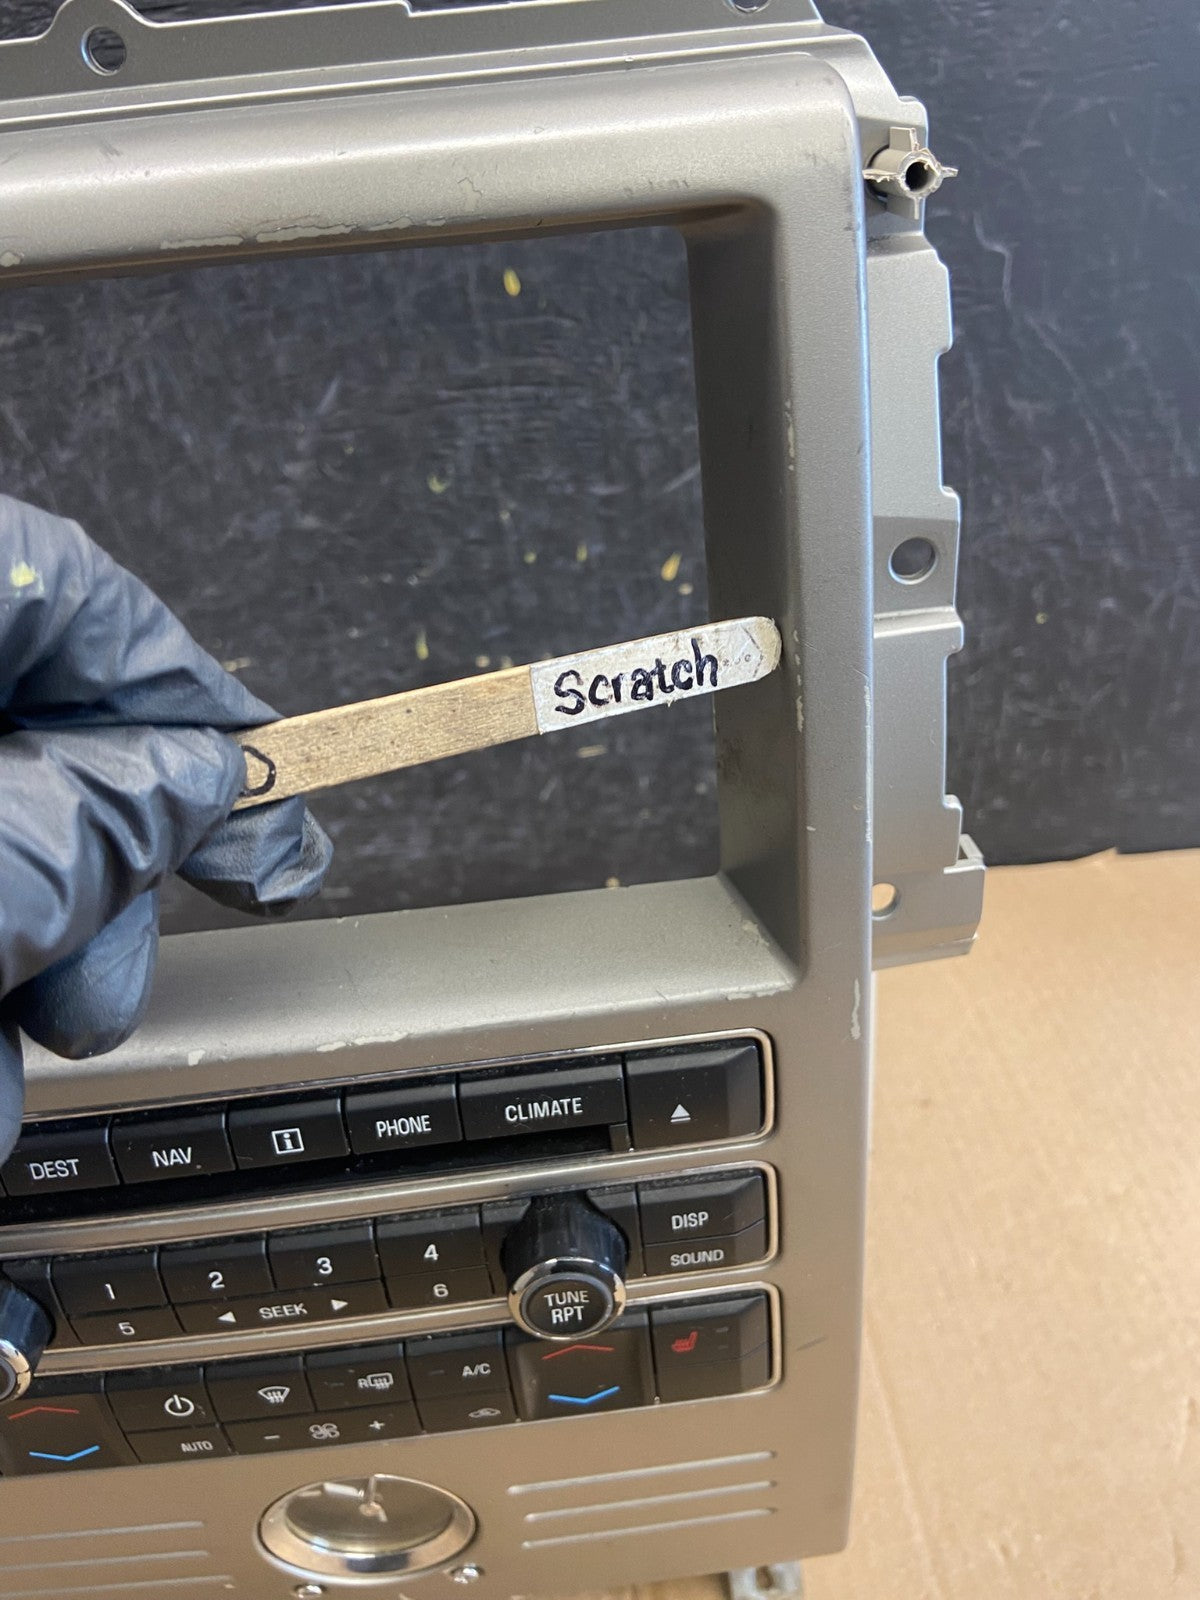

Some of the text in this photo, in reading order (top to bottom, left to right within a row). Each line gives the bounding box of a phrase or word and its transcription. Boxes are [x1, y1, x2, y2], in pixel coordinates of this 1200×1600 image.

[554, 638, 719, 716] Scratch
[504, 1097, 583, 1122] CLIMATE
[375, 1114, 432, 1138] PHONE
[152, 1146, 192, 1168] NAV
[29, 1158, 79, 1180] DEST
[671, 1211, 709, 1230] DISP
[423, 1243, 439, 1261] 4
[670, 1249, 725, 1267] SOUND
[316, 1257, 333, 1275] 3
[208, 1271, 225, 1289] 2
[105, 1283, 116, 1300] 1
[433, 1283, 449, 1298] 6
[544, 1290, 590, 1307] TUNE
[258, 1302, 308, 1319] SEEK
[551, 1305, 584, 1324] RPT
[118, 1321, 136, 1336] 5
[462, 1362, 491, 1377] A/C
[180, 1440, 214, 1453] AUTO
